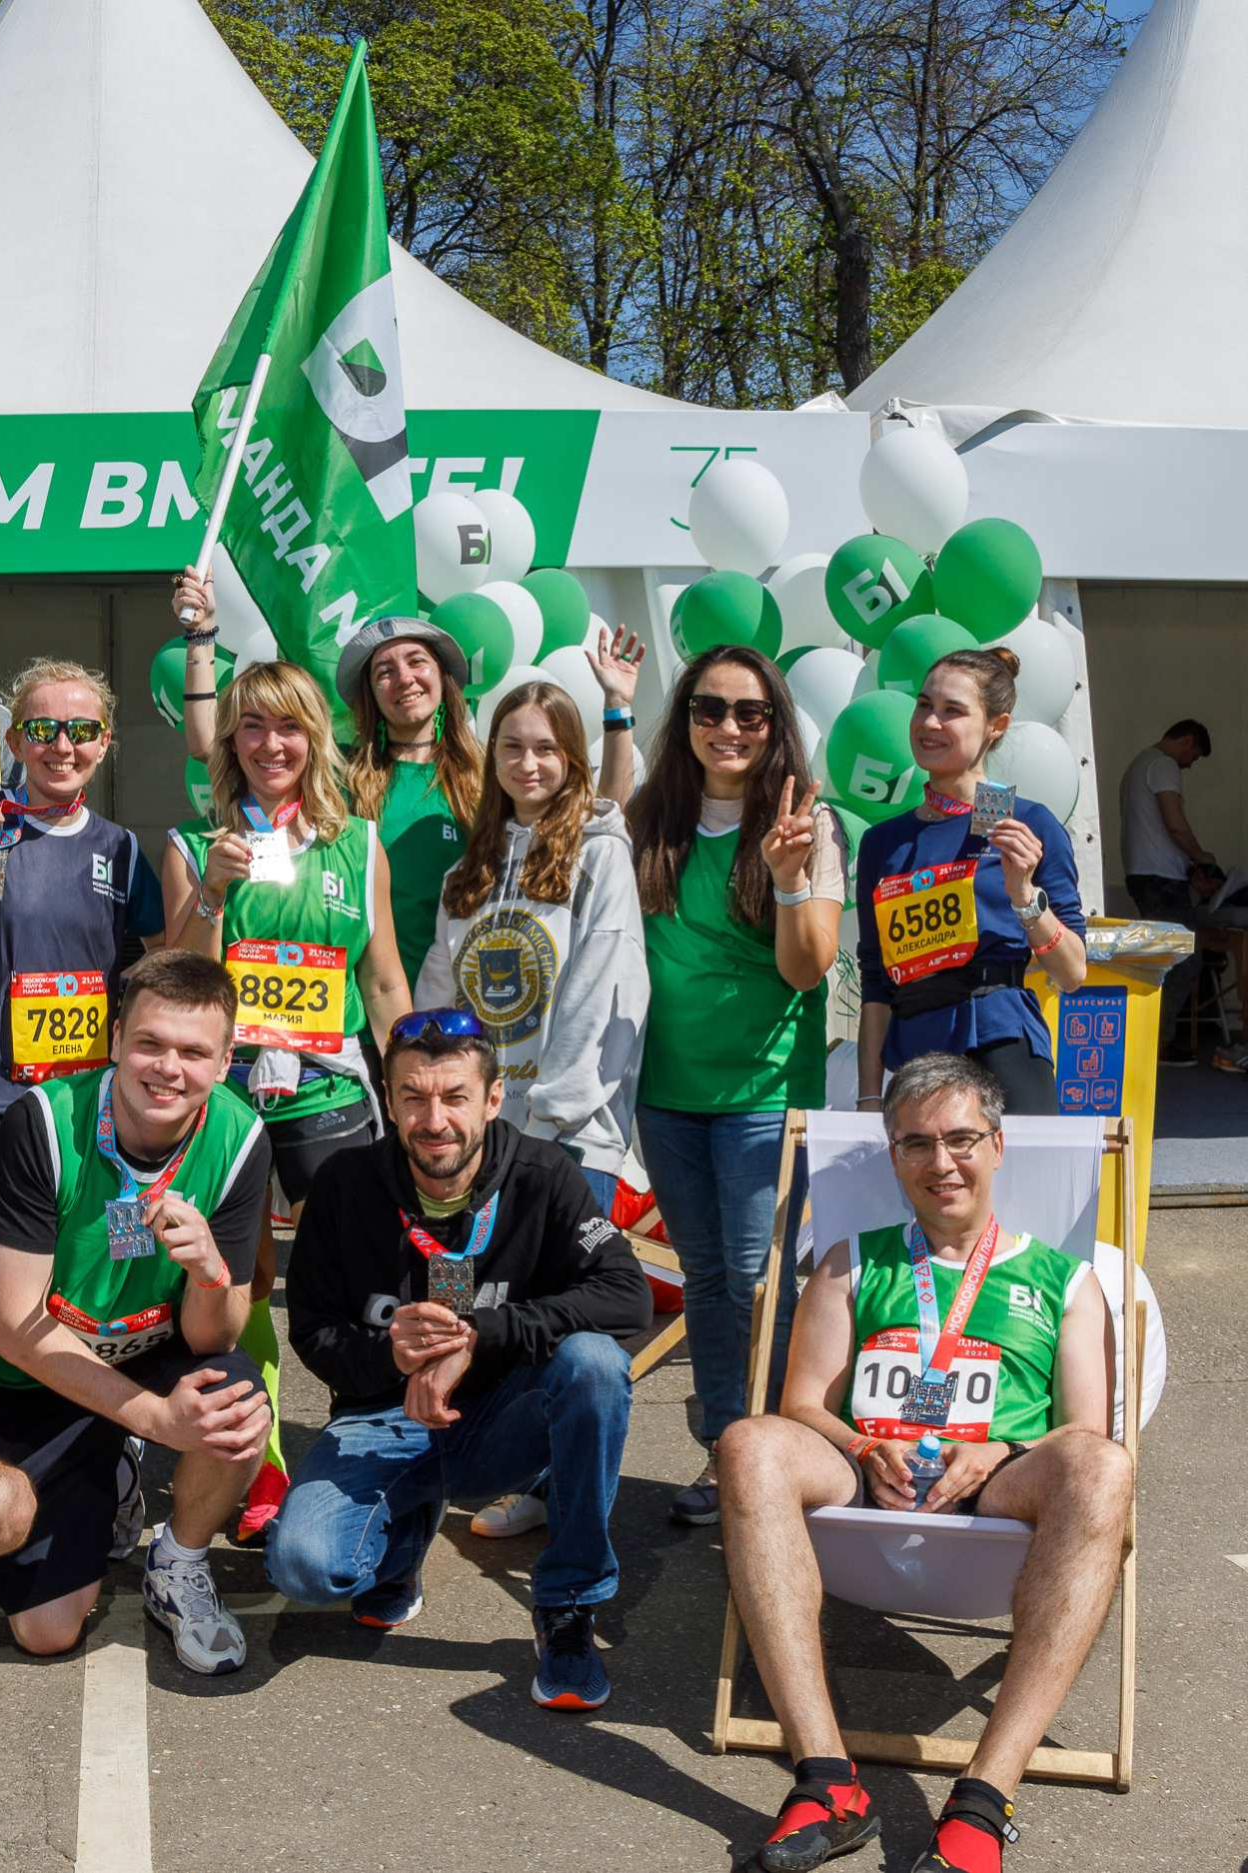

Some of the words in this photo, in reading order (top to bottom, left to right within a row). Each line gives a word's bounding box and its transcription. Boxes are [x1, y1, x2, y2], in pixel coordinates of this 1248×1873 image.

[888, 893, 962, 943] 6588
[896, 930, 956, 956] АЛЕКСАНДРА
[239, 974, 329, 1012] 8823
[27, 1007, 100, 1042] 7828
[263, 1013, 303, 1024] МАРИЯ
[52, 1044, 83, 1055] ЕЛЕНА
[864, 1362, 991, 1404] 1010
